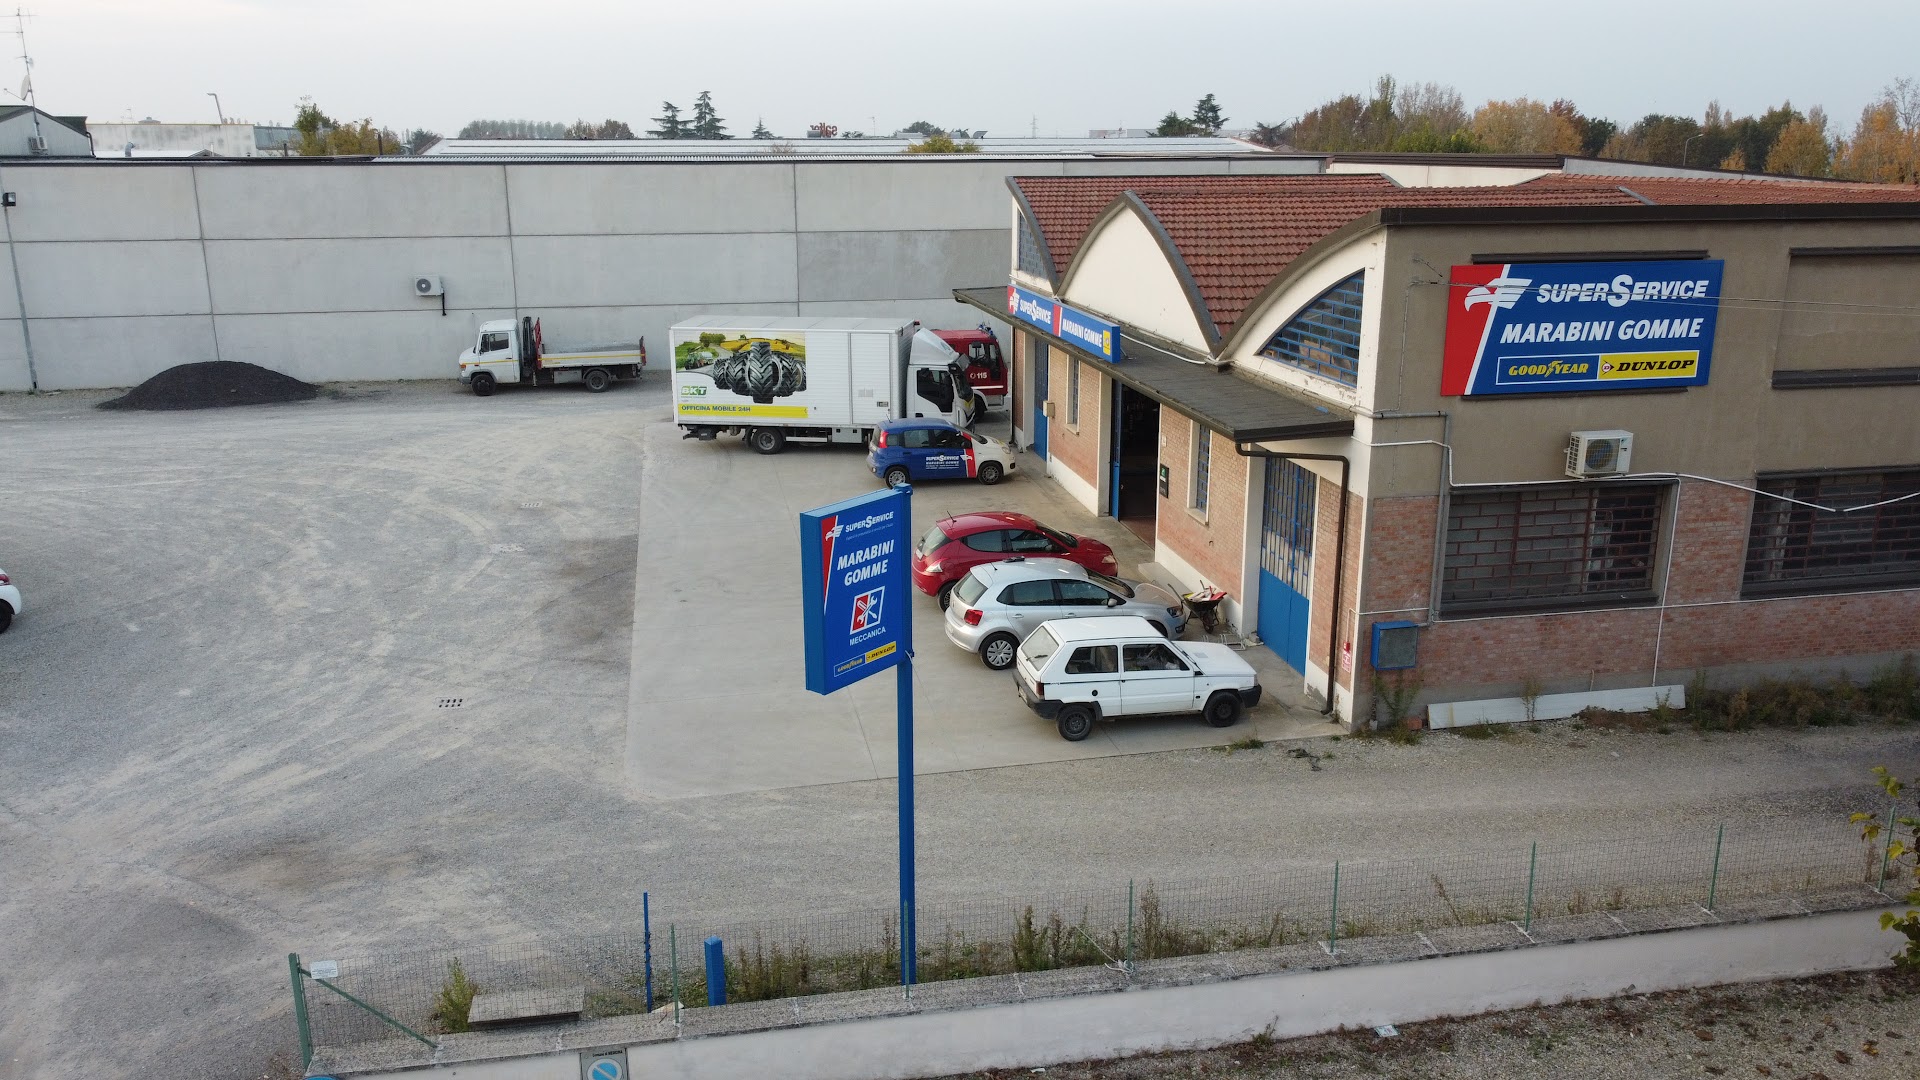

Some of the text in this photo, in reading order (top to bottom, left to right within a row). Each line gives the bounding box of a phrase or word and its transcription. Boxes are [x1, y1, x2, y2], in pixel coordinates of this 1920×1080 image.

[1536, 274, 1710, 307] SUPERSERVICE
[1020, 299, 1051, 325] SUPERSERVICE
[1062, 318, 1103, 348] MARABINI GOMME
[1499, 318, 1704, 344] MARABINI GOMME
[1508, 360, 1589, 378] GOODYEAR
[1616, 359, 1695, 373] DUNLOP
[681, 386, 707, 395] BKT
[845, 511, 894, 533] SUPERSERVICE
[837, 540, 895, 571] MARABINI
[844, 559, 889, 587] GOMME
[850, 626, 886, 646] MECCANICA
[871, 645, 896, 658] DUNLOP
